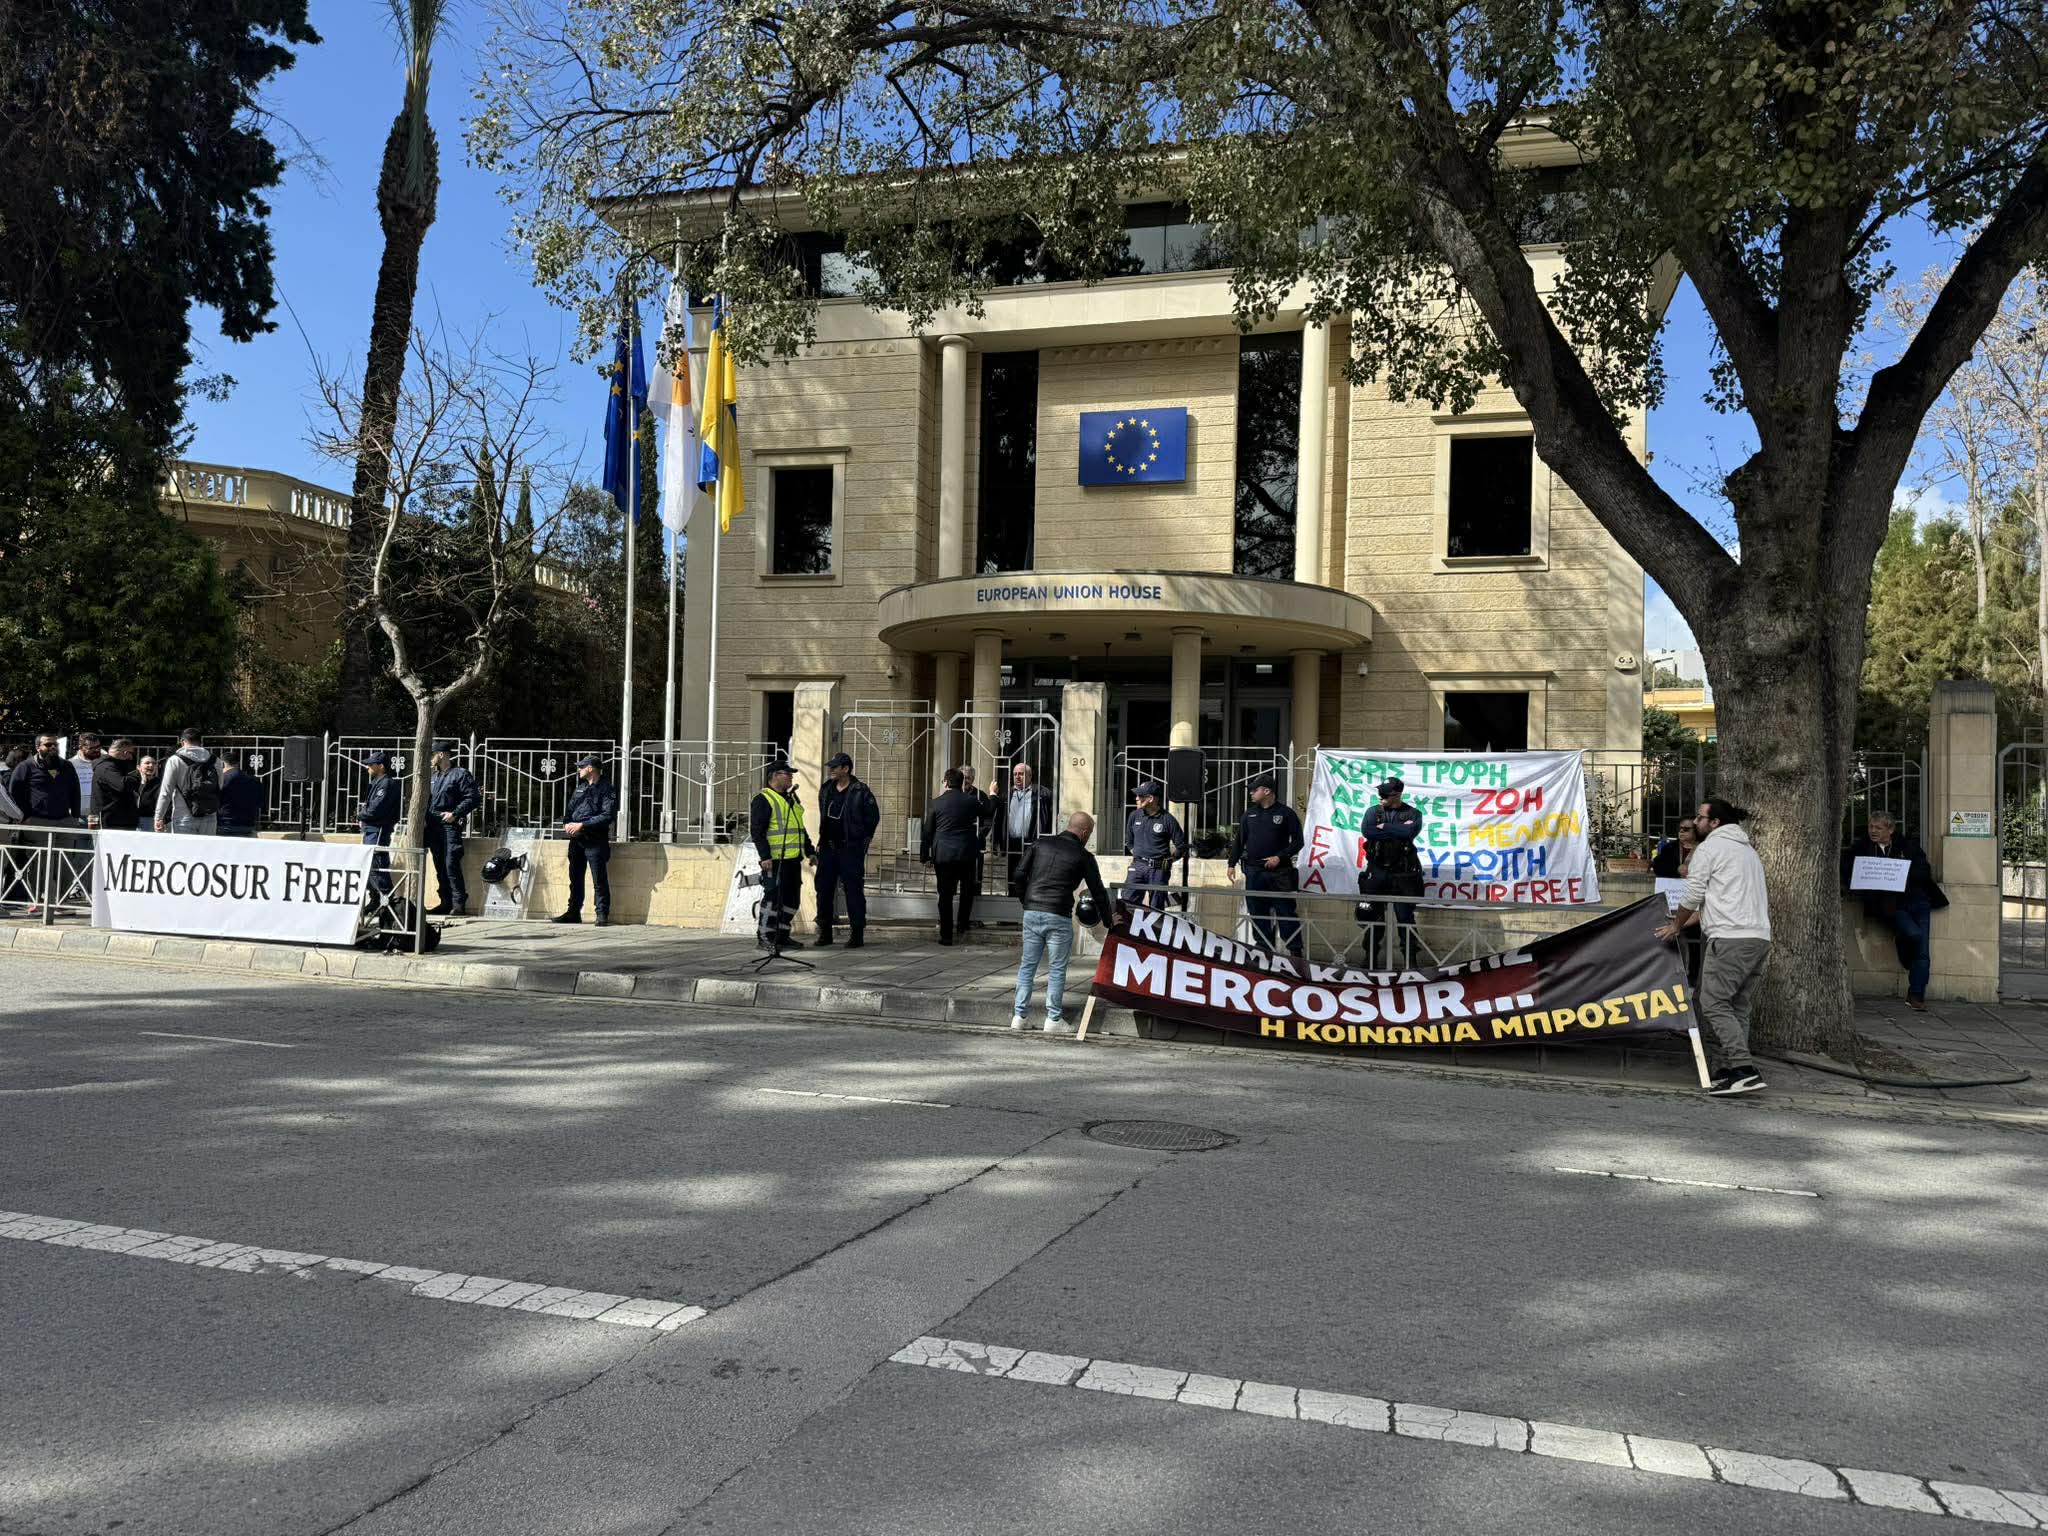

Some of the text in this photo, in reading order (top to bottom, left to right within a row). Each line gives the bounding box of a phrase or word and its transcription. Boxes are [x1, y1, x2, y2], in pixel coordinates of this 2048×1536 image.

[977, 585, 1162, 602] EUROPEAN UNION HOUSE
[1072, 757, 1086, 767] 30
[1416, 759, 1509, 787] ΤΡΟΦΗ
[1471, 786, 1543, 815] ΖΩΗ
[103, 852, 362, 906] MERCOSUR FREE
[1512, 877, 1586, 904] FREE
[1129, 908, 1301, 978] ΚΙΝΗΜΑ
[1112, 943, 1535, 1024] MERCOSUR...
[1260, 984, 1689, 1044] Η ΚΟΙΝΩΝΙΑ ΜΠΡΟΣΤΑ!
